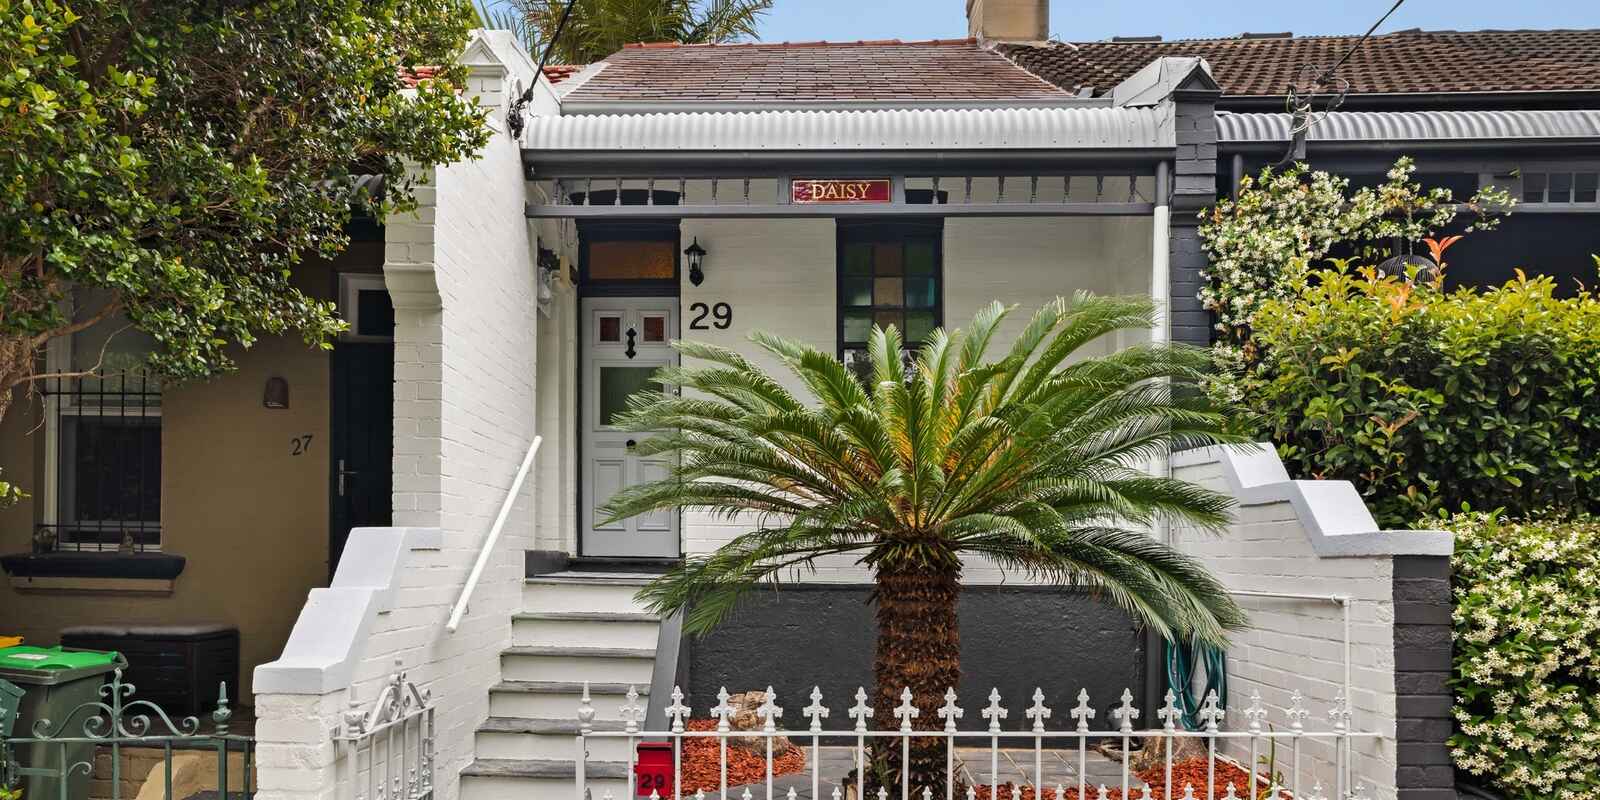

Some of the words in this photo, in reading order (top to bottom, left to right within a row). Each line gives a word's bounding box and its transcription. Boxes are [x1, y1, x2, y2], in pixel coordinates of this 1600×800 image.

[811, 183, 871, 199] DAISY
[689, 302, 732, 330] 29
[291, 435, 313, 456] 27
[641, 773, 665, 790] 29
